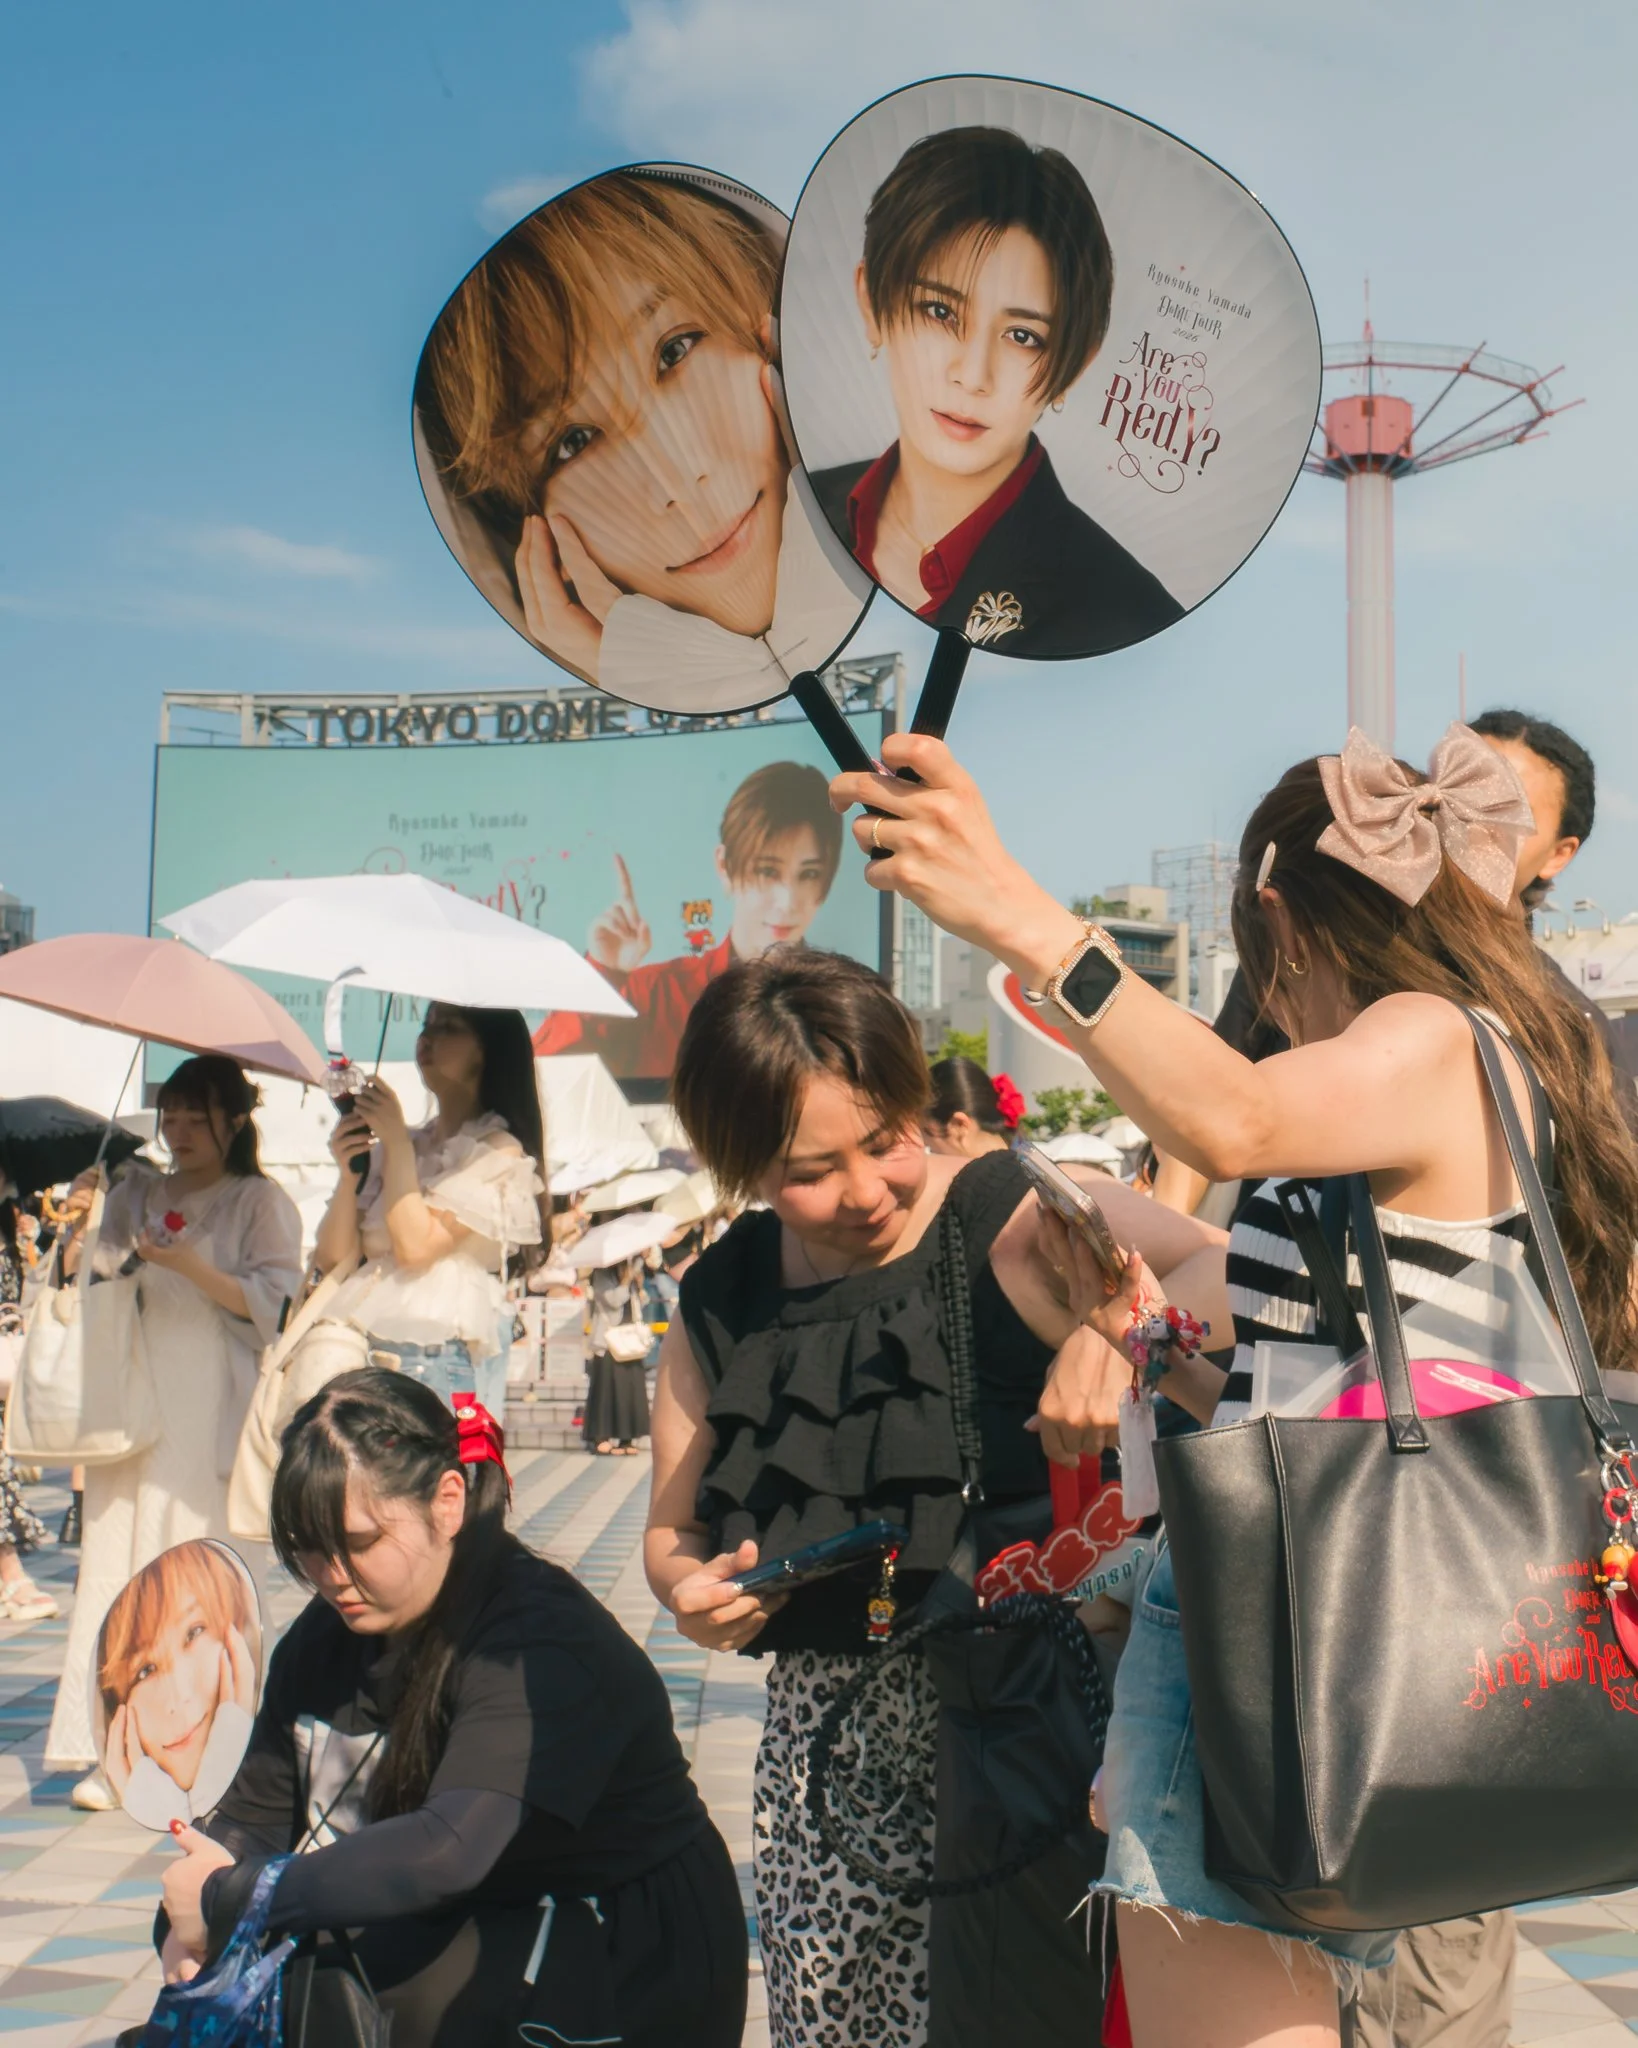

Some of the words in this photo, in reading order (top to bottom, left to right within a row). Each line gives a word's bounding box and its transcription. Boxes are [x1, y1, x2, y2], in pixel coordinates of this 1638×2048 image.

[1147, 263, 1200, 297] Ryosuke
[1207, 288, 1252, 320] Yamada
[1119, 331, 1175, 375] Are
[1172, 327, 1200, 343] 2026
[315, 702, 479, 748] TOKYO
[496, 697, 628, 738] DOME
[1464, 1645, 1531, 1704] Are
